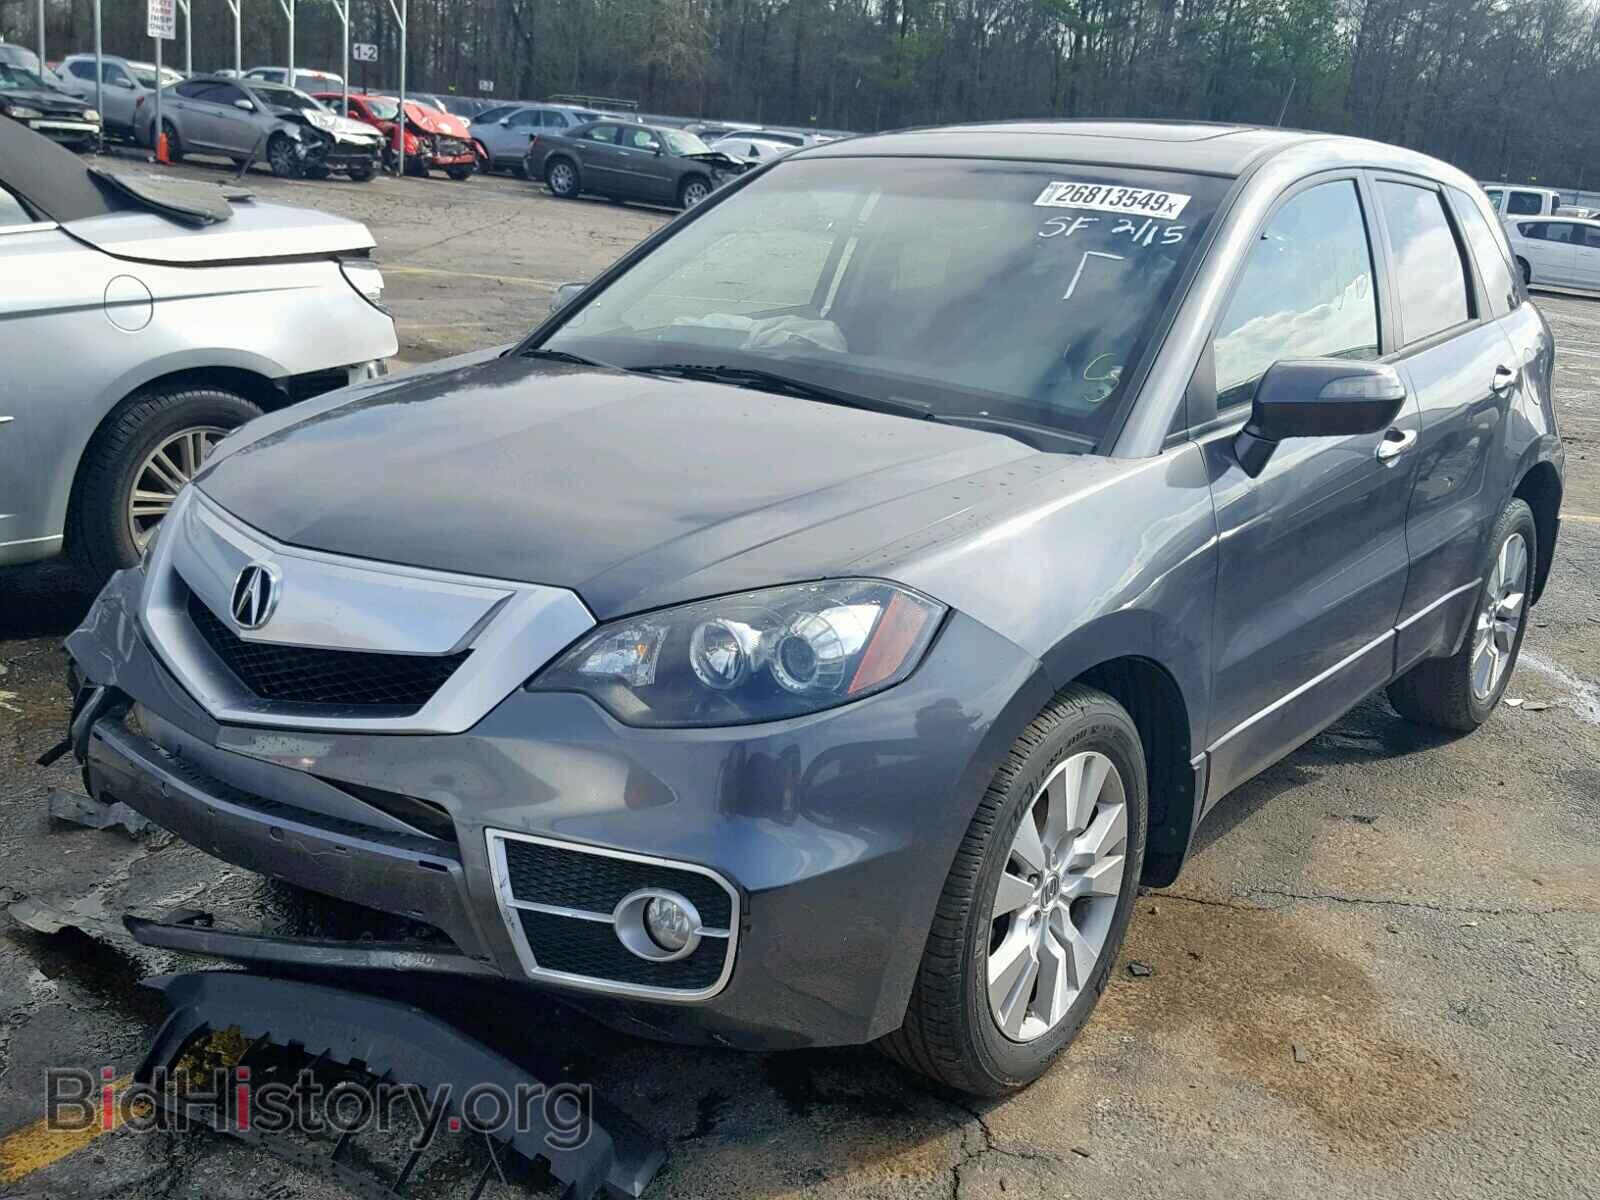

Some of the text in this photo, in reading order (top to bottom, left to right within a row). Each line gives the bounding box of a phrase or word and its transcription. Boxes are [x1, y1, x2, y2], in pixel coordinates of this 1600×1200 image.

[150, 15, 172, 23] INSP
[150, 23, 173, 32] ONLY
[355, 45, 376, 59] 1-2
